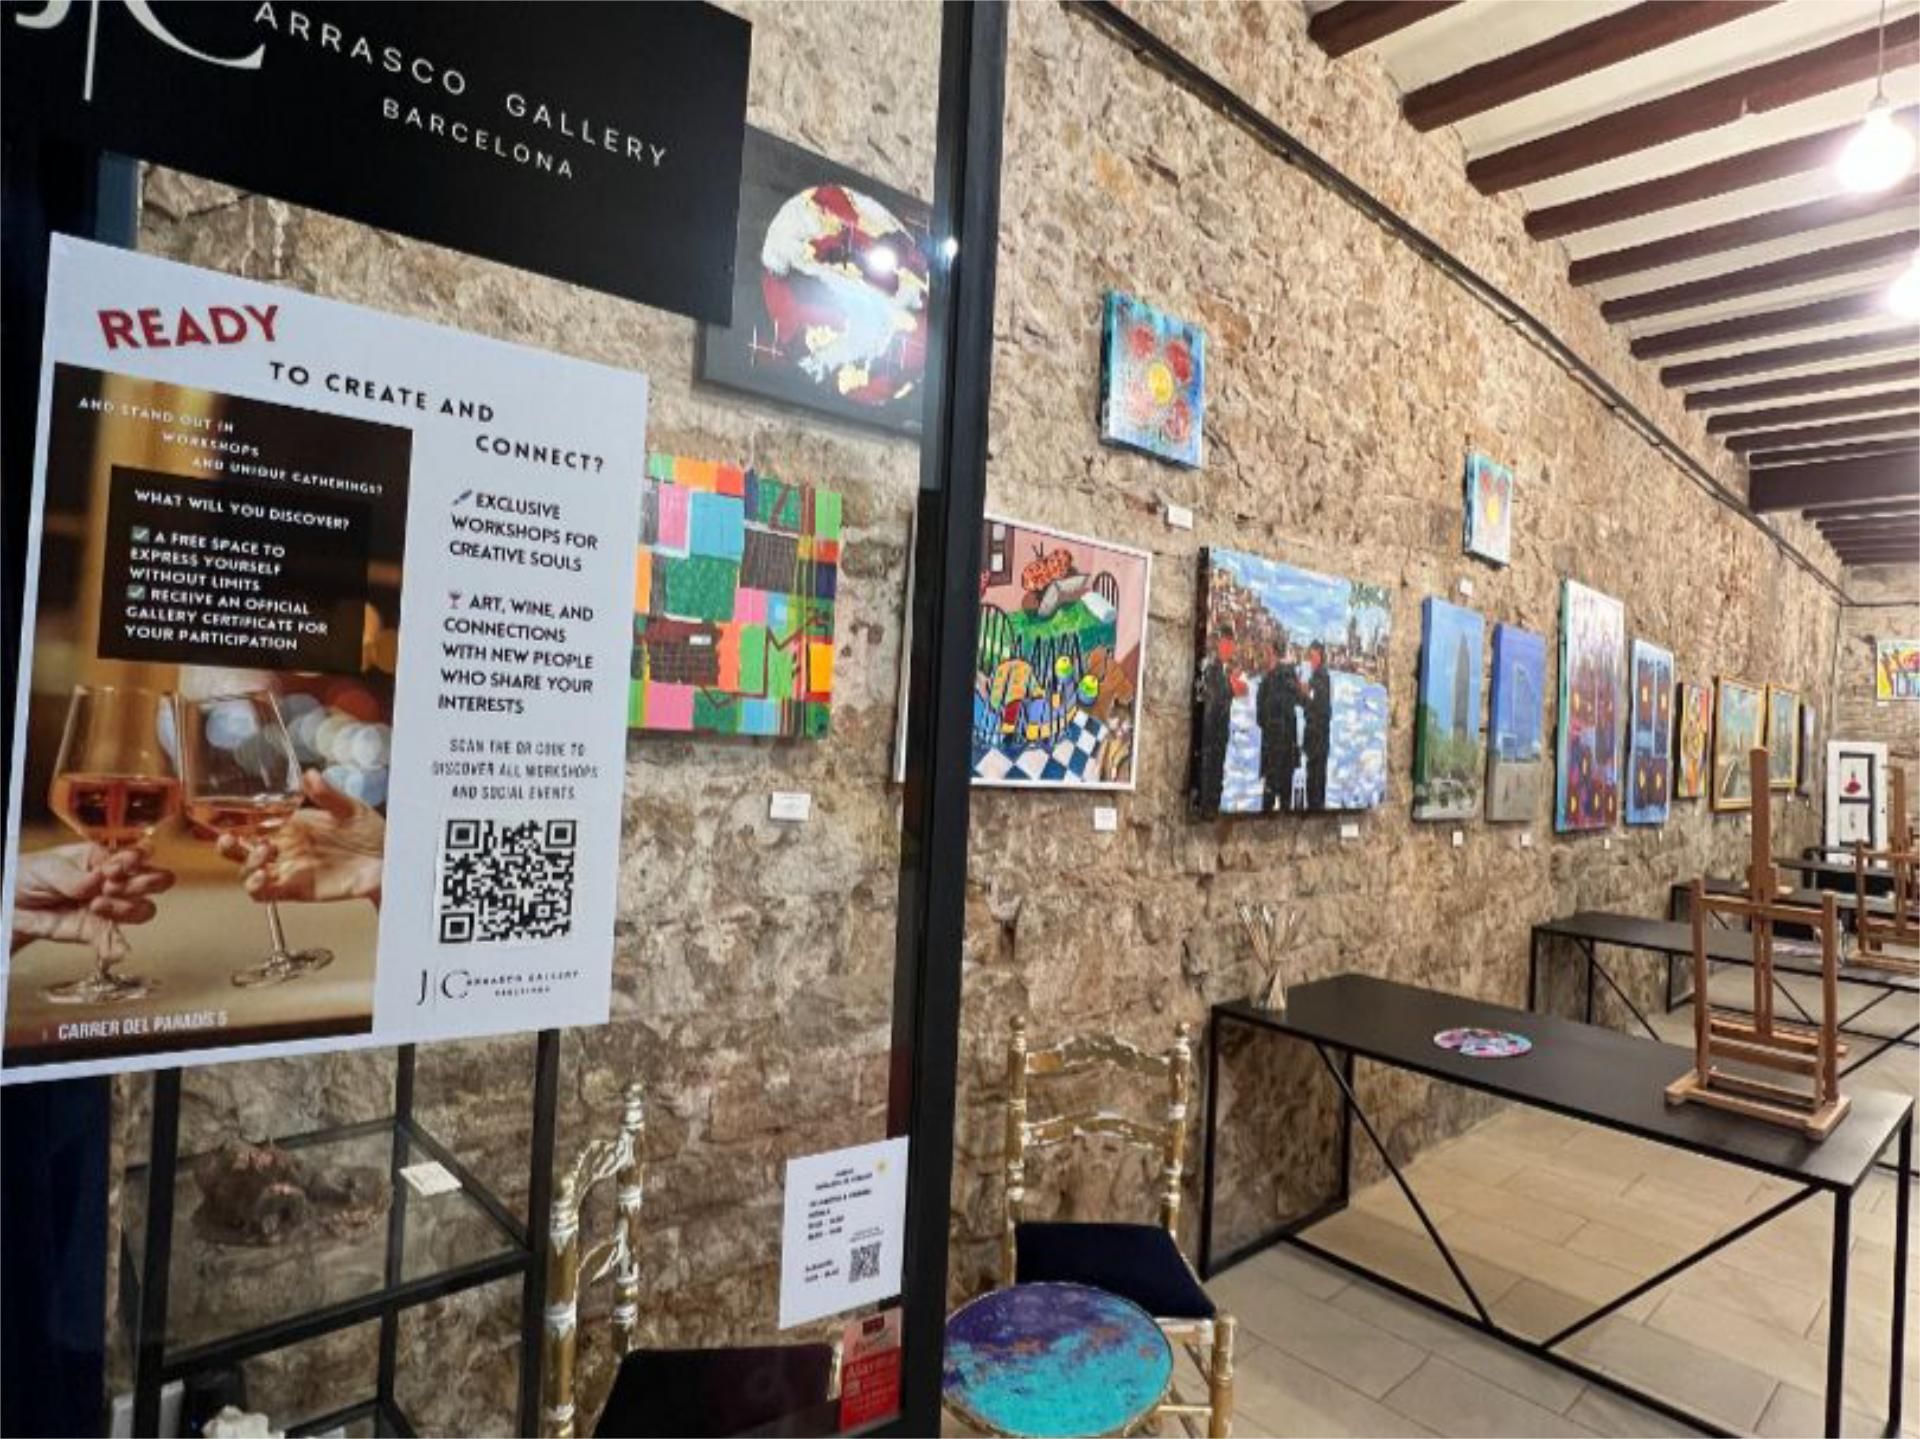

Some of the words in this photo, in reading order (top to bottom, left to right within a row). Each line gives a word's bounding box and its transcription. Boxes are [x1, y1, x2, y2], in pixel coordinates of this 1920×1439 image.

[383, 98, 574, 180] BARCELONA
[506, 93, 667, 170] GALLERY
[98, 305, 280, 351] READY
[269, 361, 310, 386] TO
[325, 373, 427, 411] CREATE
[440, 397, 495, 423] AND
[78, 398, 114, 413] AND
[122, 405, 174, 424] STAND
[179, 415, 212, 431] OUT
[217, 421, 234, 433] IN
[162, 431, 260, 458] WORKSHOPS
[476, 434, 605, 473] CONNECT?
[191, 457, 224, 471] AND
[230, 462, 287, 481] UNIQUE
[134, 489, 182, 508] WHAT
[188, 497, 224, 513] WILL
[230, 502, 264, 518] YOU
[269, 509, 350, 531] DISCOVER?
[475, 492, 561, 520] EXCLUSIVE
[154, 531, 166, 543] A
[170, 533, 207, 549] FREE
[211, 538, 260, 555] SPACE
[263, 544, 286, 558] TO
[450, 514, 561, 544] WORKSHOPS
[566, 532, 599, 550] FOR
[130, 547, 198, 567] EXPRESS
[203, 555, 282, 576] YOURSELF
[450, 540, 526, 565] CREATIVE
[530, 552, 583, 572] SOULS
[129, 567, 208, 587] WITHOUT
[211, 577, 261, 592] LIMITS
[151, 589, 213, 606] RECEIVE
[218, 596, 240, 610] AN
[244, 599, 309, 615] OFFICIAL
[468, 594, 506, 614] ART,
[511, 599, 555, 619] WINE,
[559, 605, 594, 622] AND
[126, 605, 198, 624] GALLERY
[202, 613, 293, 633] CERTIFICATE
[297, 621, 329, 636] FOR
[443, 617, 567, 644] CONNECTIONS
[125, 624, 174, 641] YOUR
[178, 630, 298, 650] PARTICIPATION
[441, 642, 487, 661] WITH
[490, 647, 529, 665] NEW
[533, 650, 594, 670] PEOPLE
[440, 668, 487, 687] WHO
[490, 671, 541, 691] SHARE
[546, 677, 594, 694] YOUR
[438, 693, 525, 715] INTERESTS
[449, 738, 485, 754] SCAN
[489, 739, 511, 755] THE
[570, 741, 586, 757] TO
[432, 760, 495, 777] DISCOVER
[499, 762, 521, 778] ALL
[525, 764, 599, 779] WORKSHOPS
[452, 785, 478, 799] AND
[481, 785, 524, 800] SOCIAL
[528, 785, 576, 800] EVENTS
[58, 1019, 120, 1041] CARRER
[123, 1016, 149, 1035] DEL
